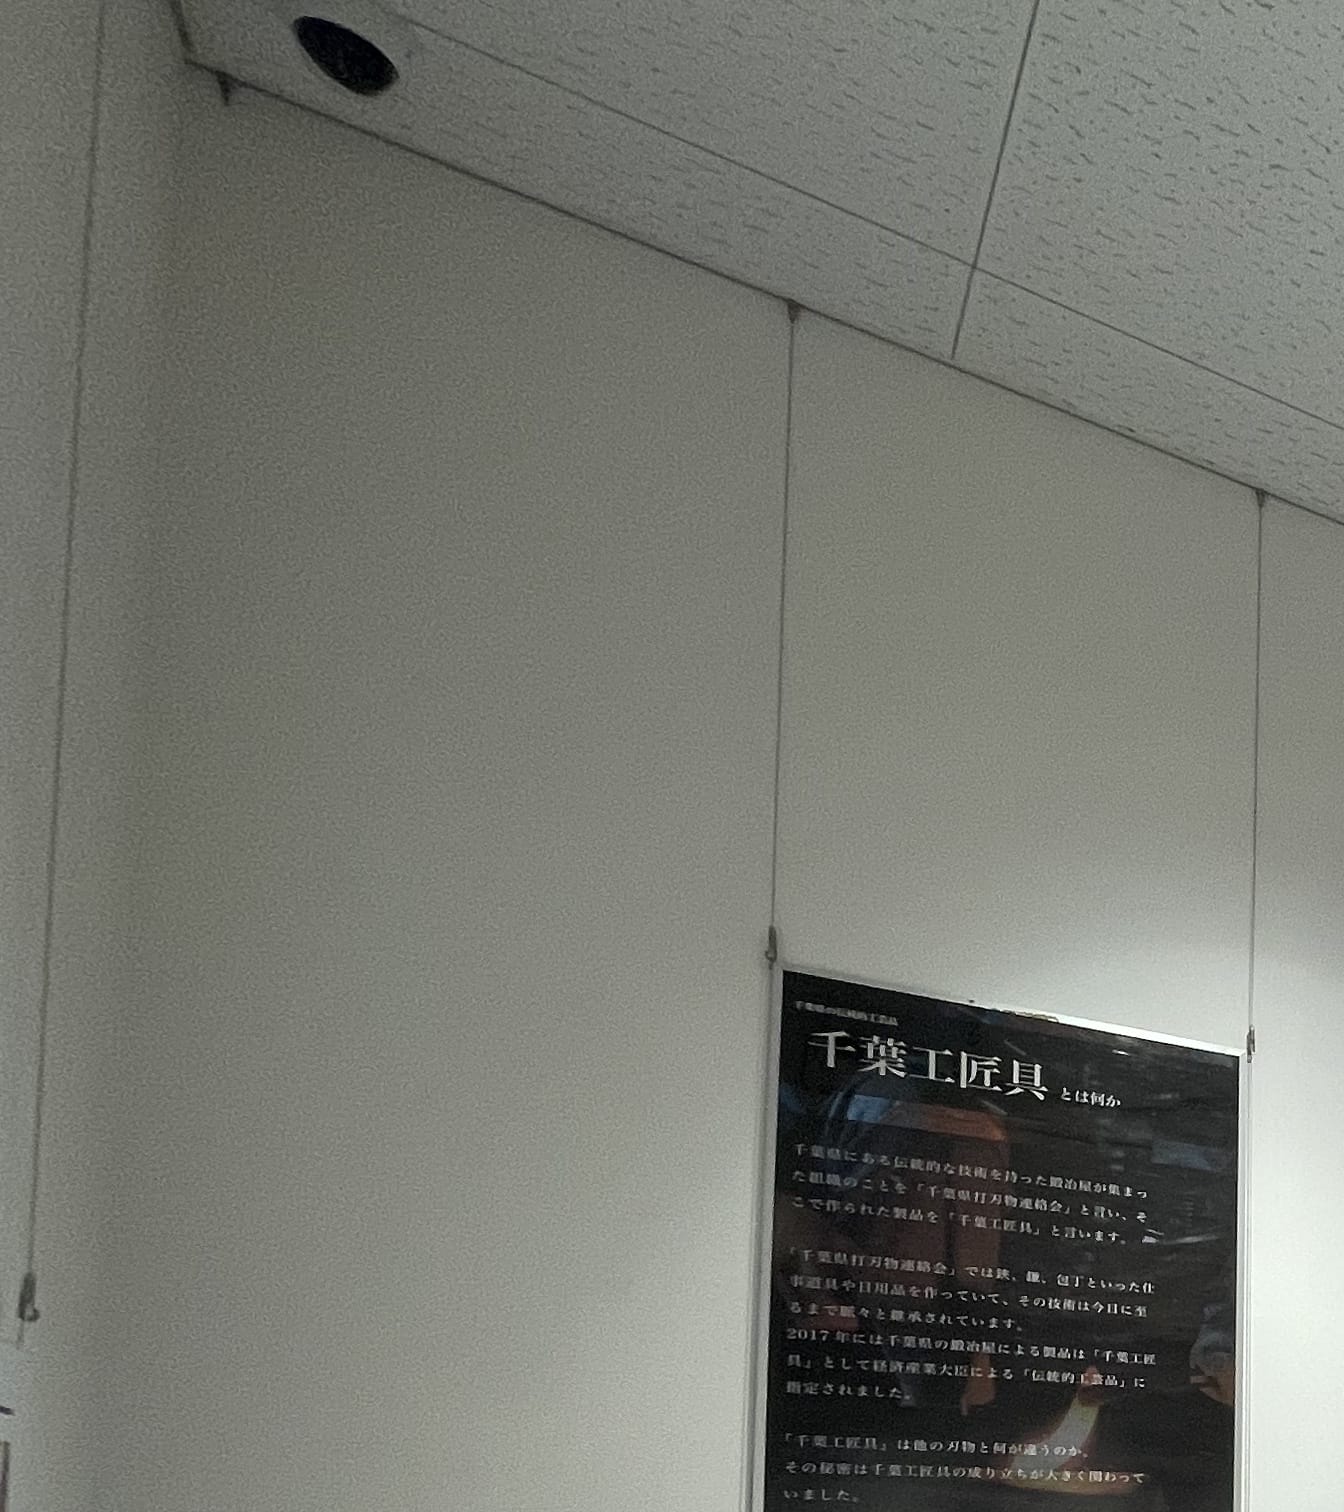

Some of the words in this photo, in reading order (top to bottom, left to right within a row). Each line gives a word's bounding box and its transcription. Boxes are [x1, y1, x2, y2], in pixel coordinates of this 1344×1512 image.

[807, 1024, 1049, 1102] 千葉工匠具
[1060, 1085, 1120, 1109] とは何か
[786, 1379, 912, 1401] 指定されました。
[783, 1486, 860, 1503] いました。
